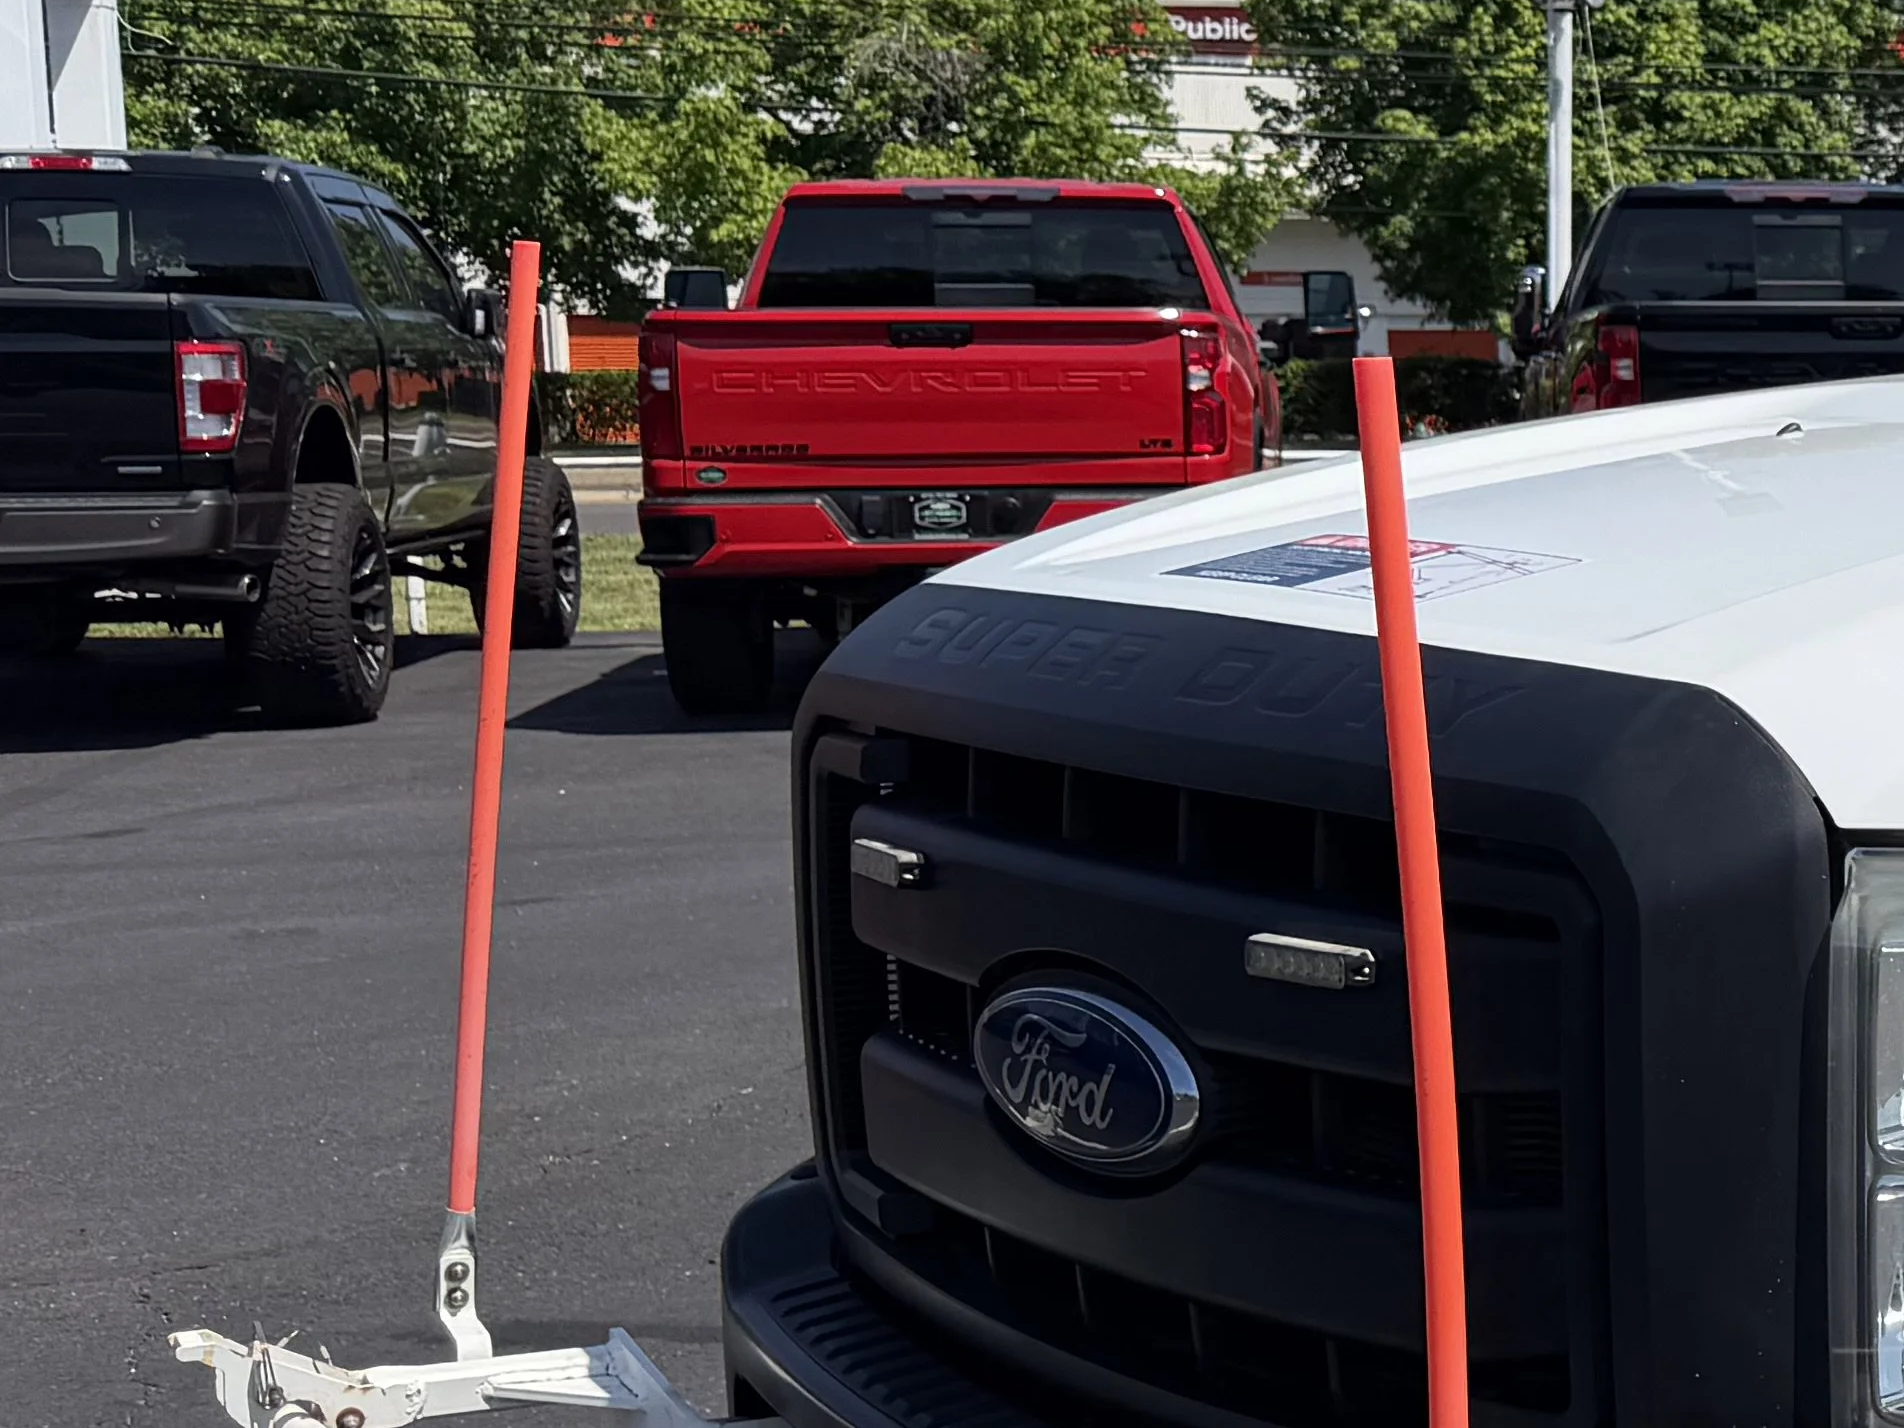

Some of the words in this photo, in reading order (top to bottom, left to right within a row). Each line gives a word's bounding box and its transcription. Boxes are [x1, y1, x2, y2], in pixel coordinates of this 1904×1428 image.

[1169, 13, 1258, 41] Public
[712, 369, 1147, 394] CHEVROLET
[894, 608, 1165, 691] SUPER
[1002, 1013, 1116, 1130] Ford
